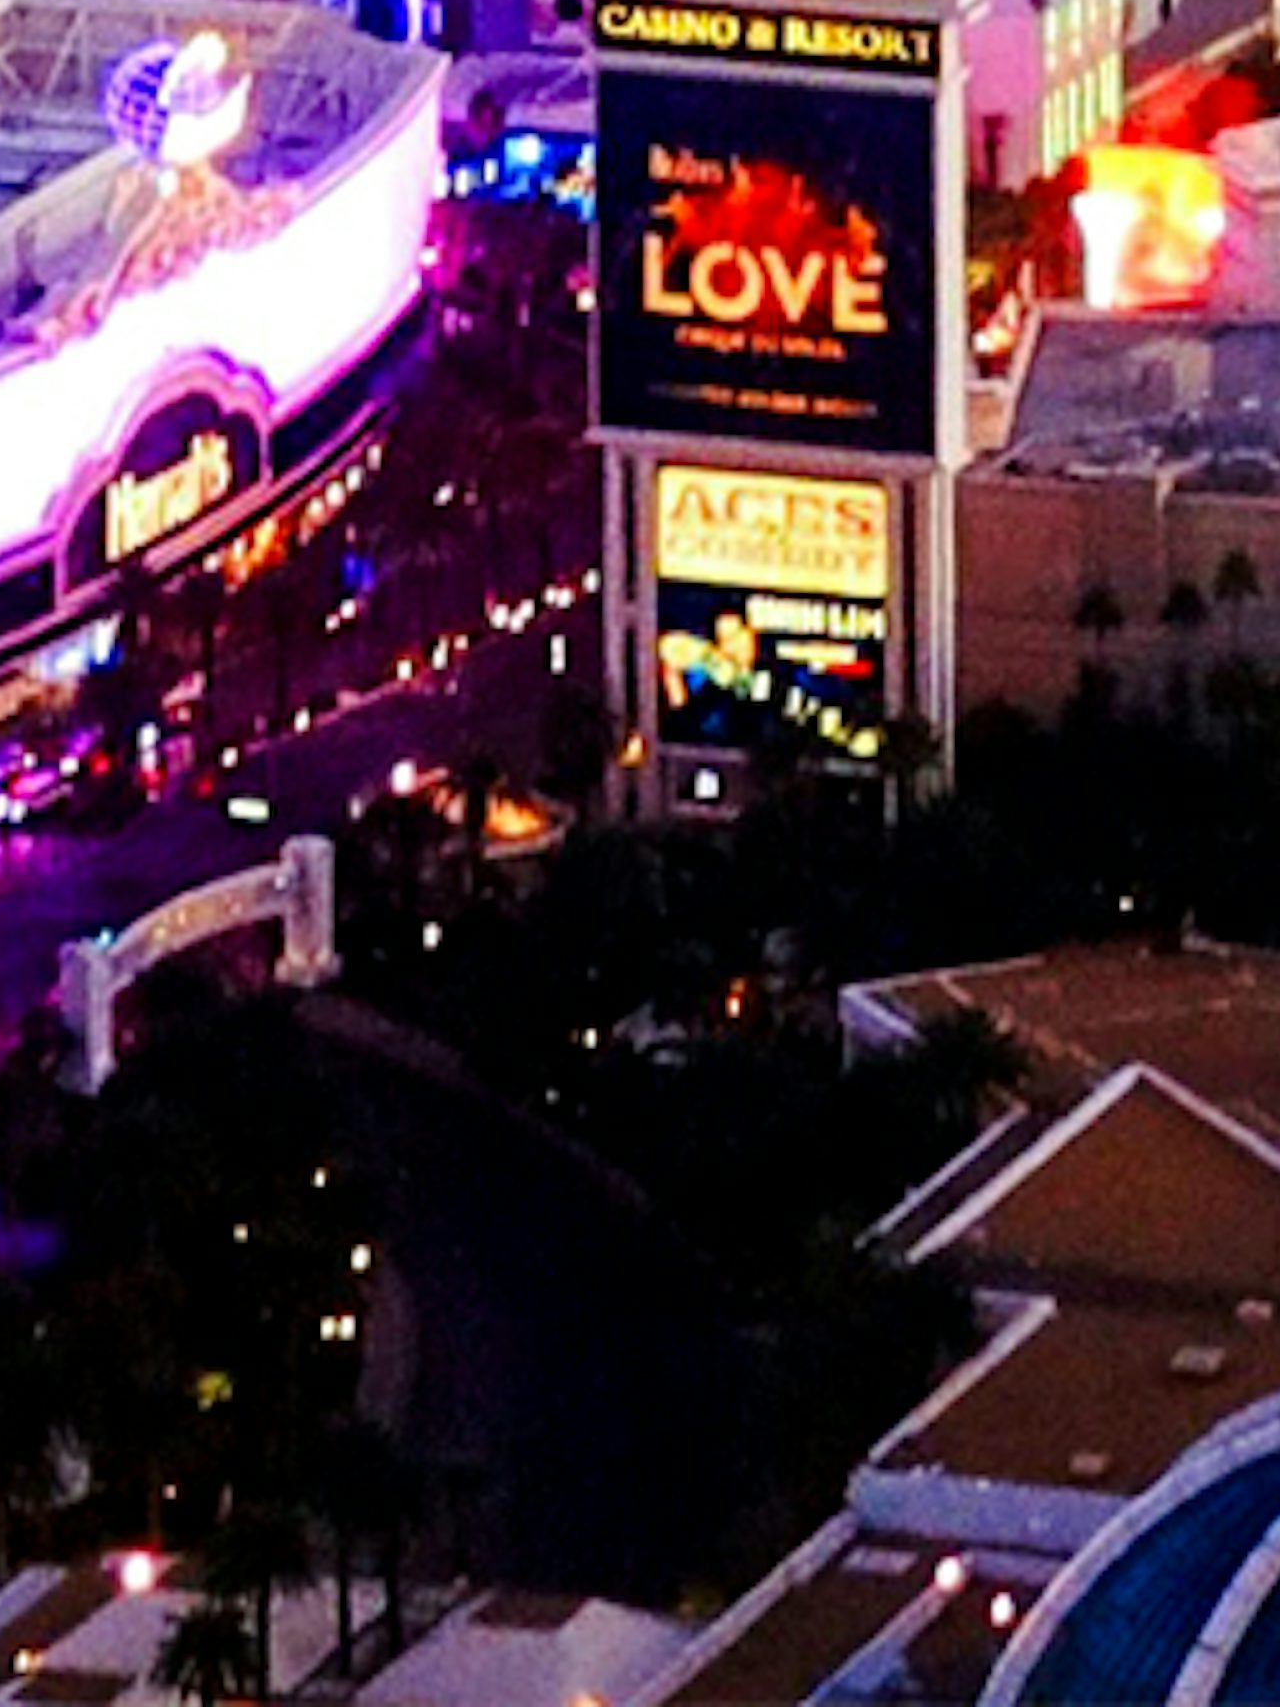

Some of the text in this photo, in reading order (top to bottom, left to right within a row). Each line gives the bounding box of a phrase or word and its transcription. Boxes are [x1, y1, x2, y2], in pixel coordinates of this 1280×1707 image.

[597, 3, 740, 49] CASINO
[782, 15, 931, 62] RESORT
[643, 232, 888, 333] LOVE
